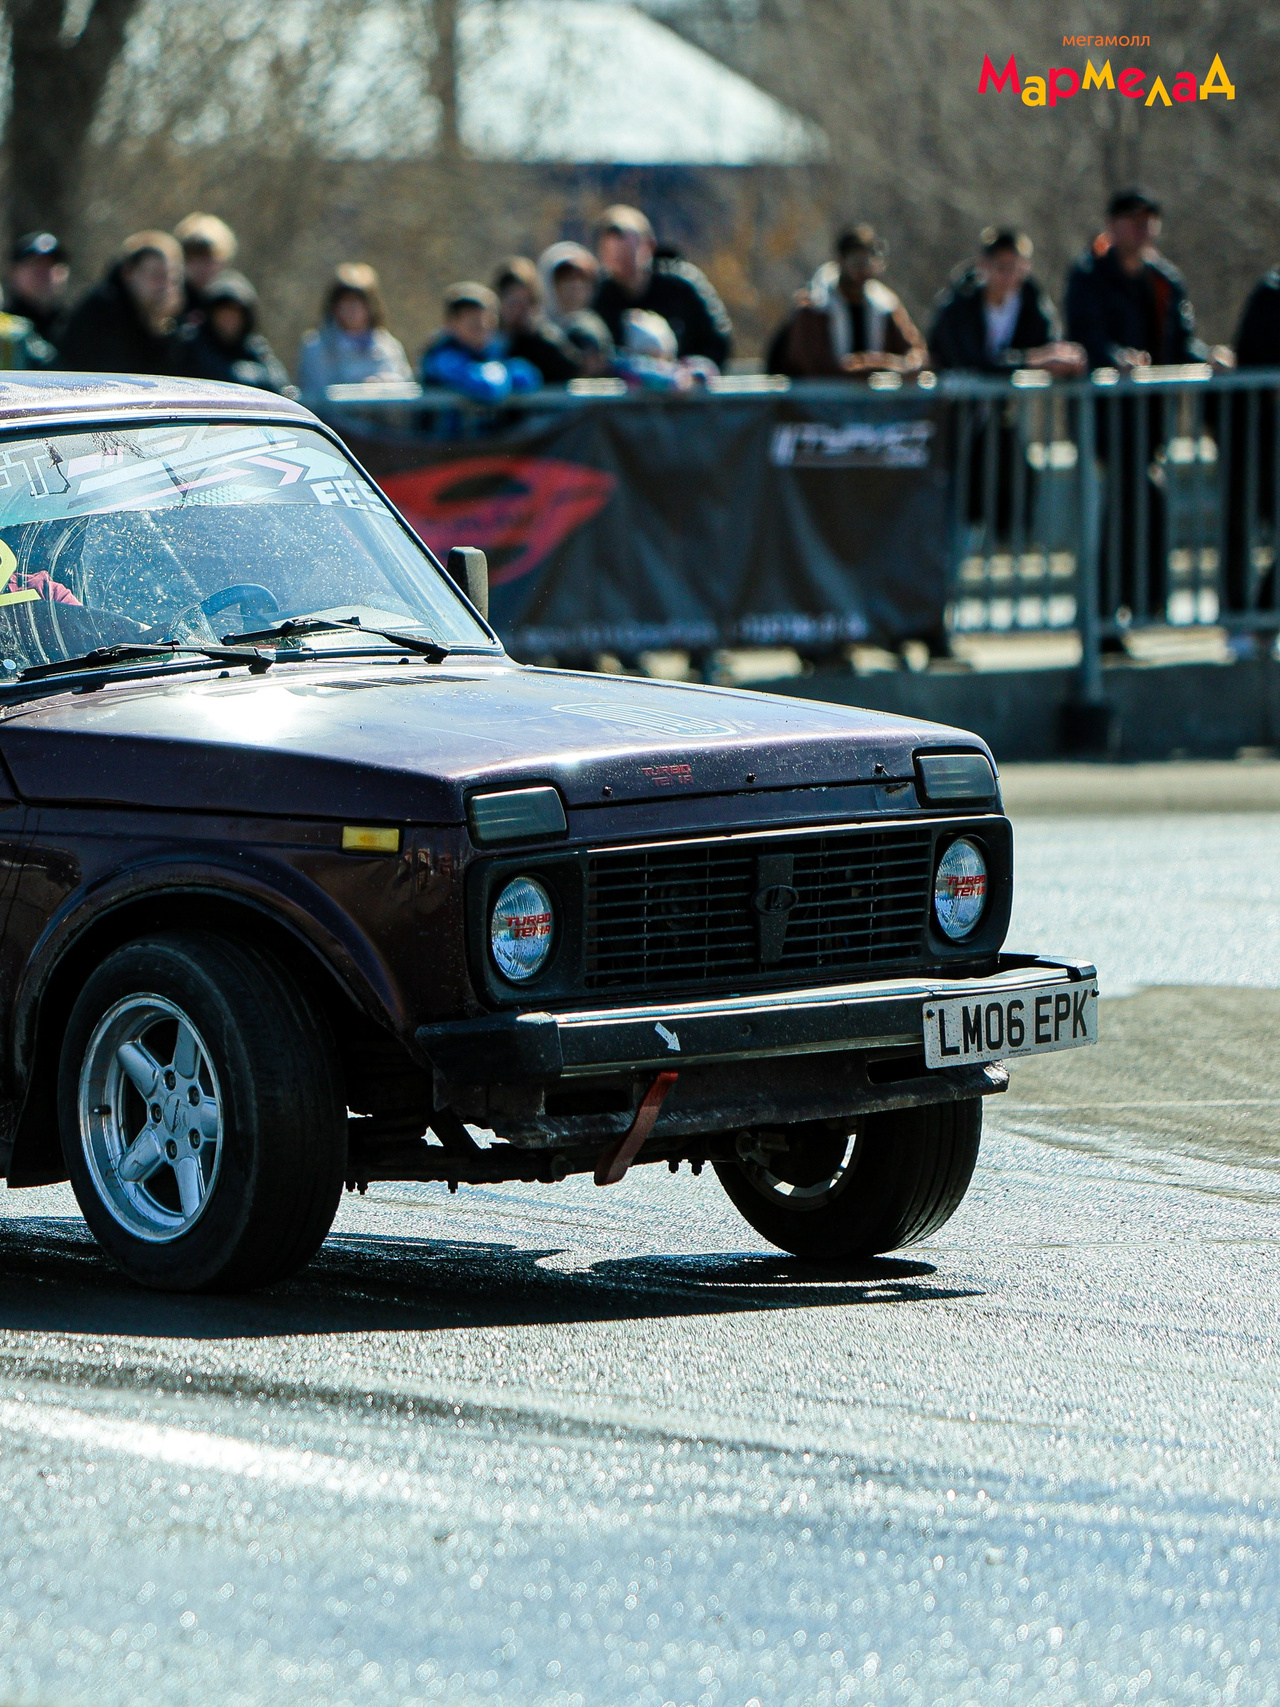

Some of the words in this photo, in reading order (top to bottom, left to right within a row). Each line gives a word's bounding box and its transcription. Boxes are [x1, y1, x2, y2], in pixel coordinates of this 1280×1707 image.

[640, 764, 692, 777] TURBO
[505, 912, 551, 928] TURBO
[1034, 989, 1089, 1045] EPK
